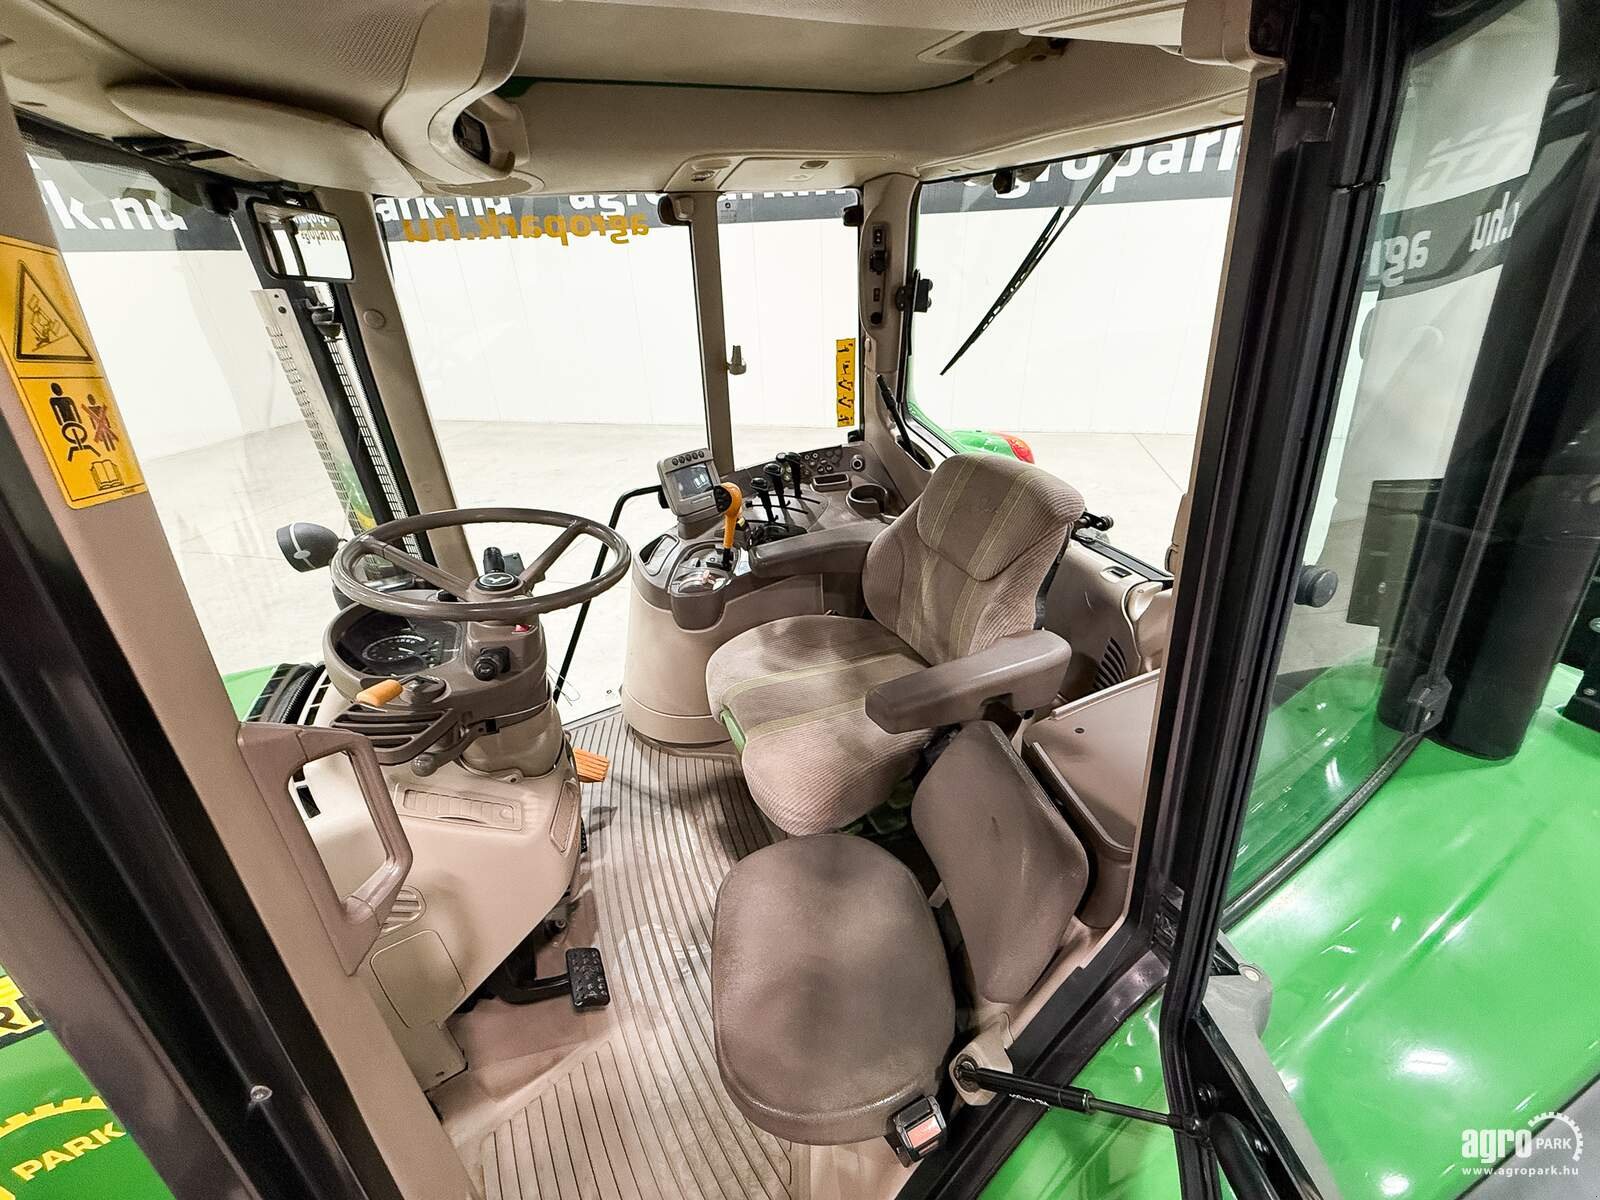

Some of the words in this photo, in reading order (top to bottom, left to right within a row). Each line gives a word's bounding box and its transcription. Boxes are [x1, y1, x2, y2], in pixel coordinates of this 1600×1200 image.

[966, 125, 1240, 199] opar
[41, 180, 188, 230] k.hu
[12, 1122, 126, 1181] PARK
